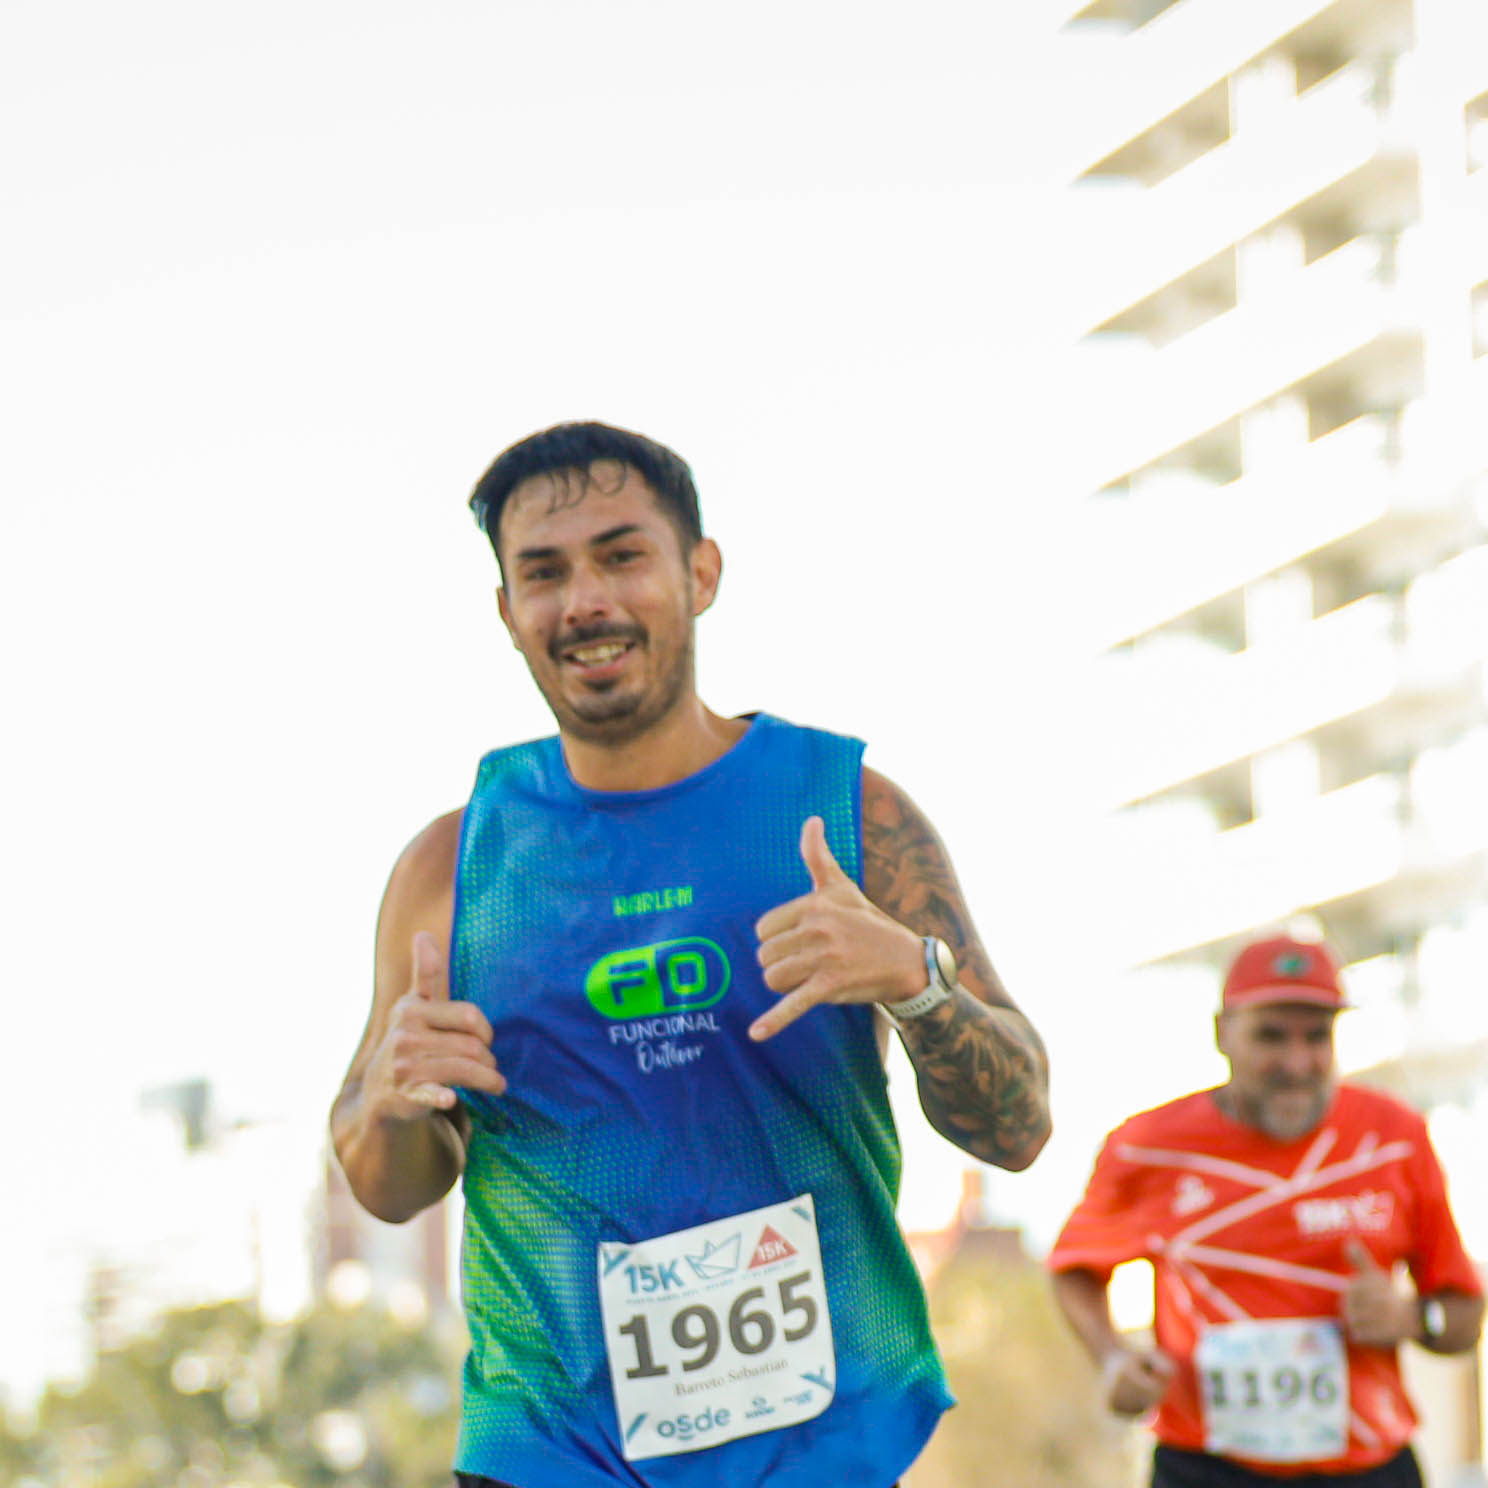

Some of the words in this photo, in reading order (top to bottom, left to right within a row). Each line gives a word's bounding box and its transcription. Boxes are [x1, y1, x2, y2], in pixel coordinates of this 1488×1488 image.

[608, 1012, 720, 1045] FUNCIONAL
[623, 1259, 685, 1294] 15K
[619, 1270, 819, 1380] 1965
[1209, 1364, 1338, 1409] 1196
[657, 1406, 732, 1439] osde
